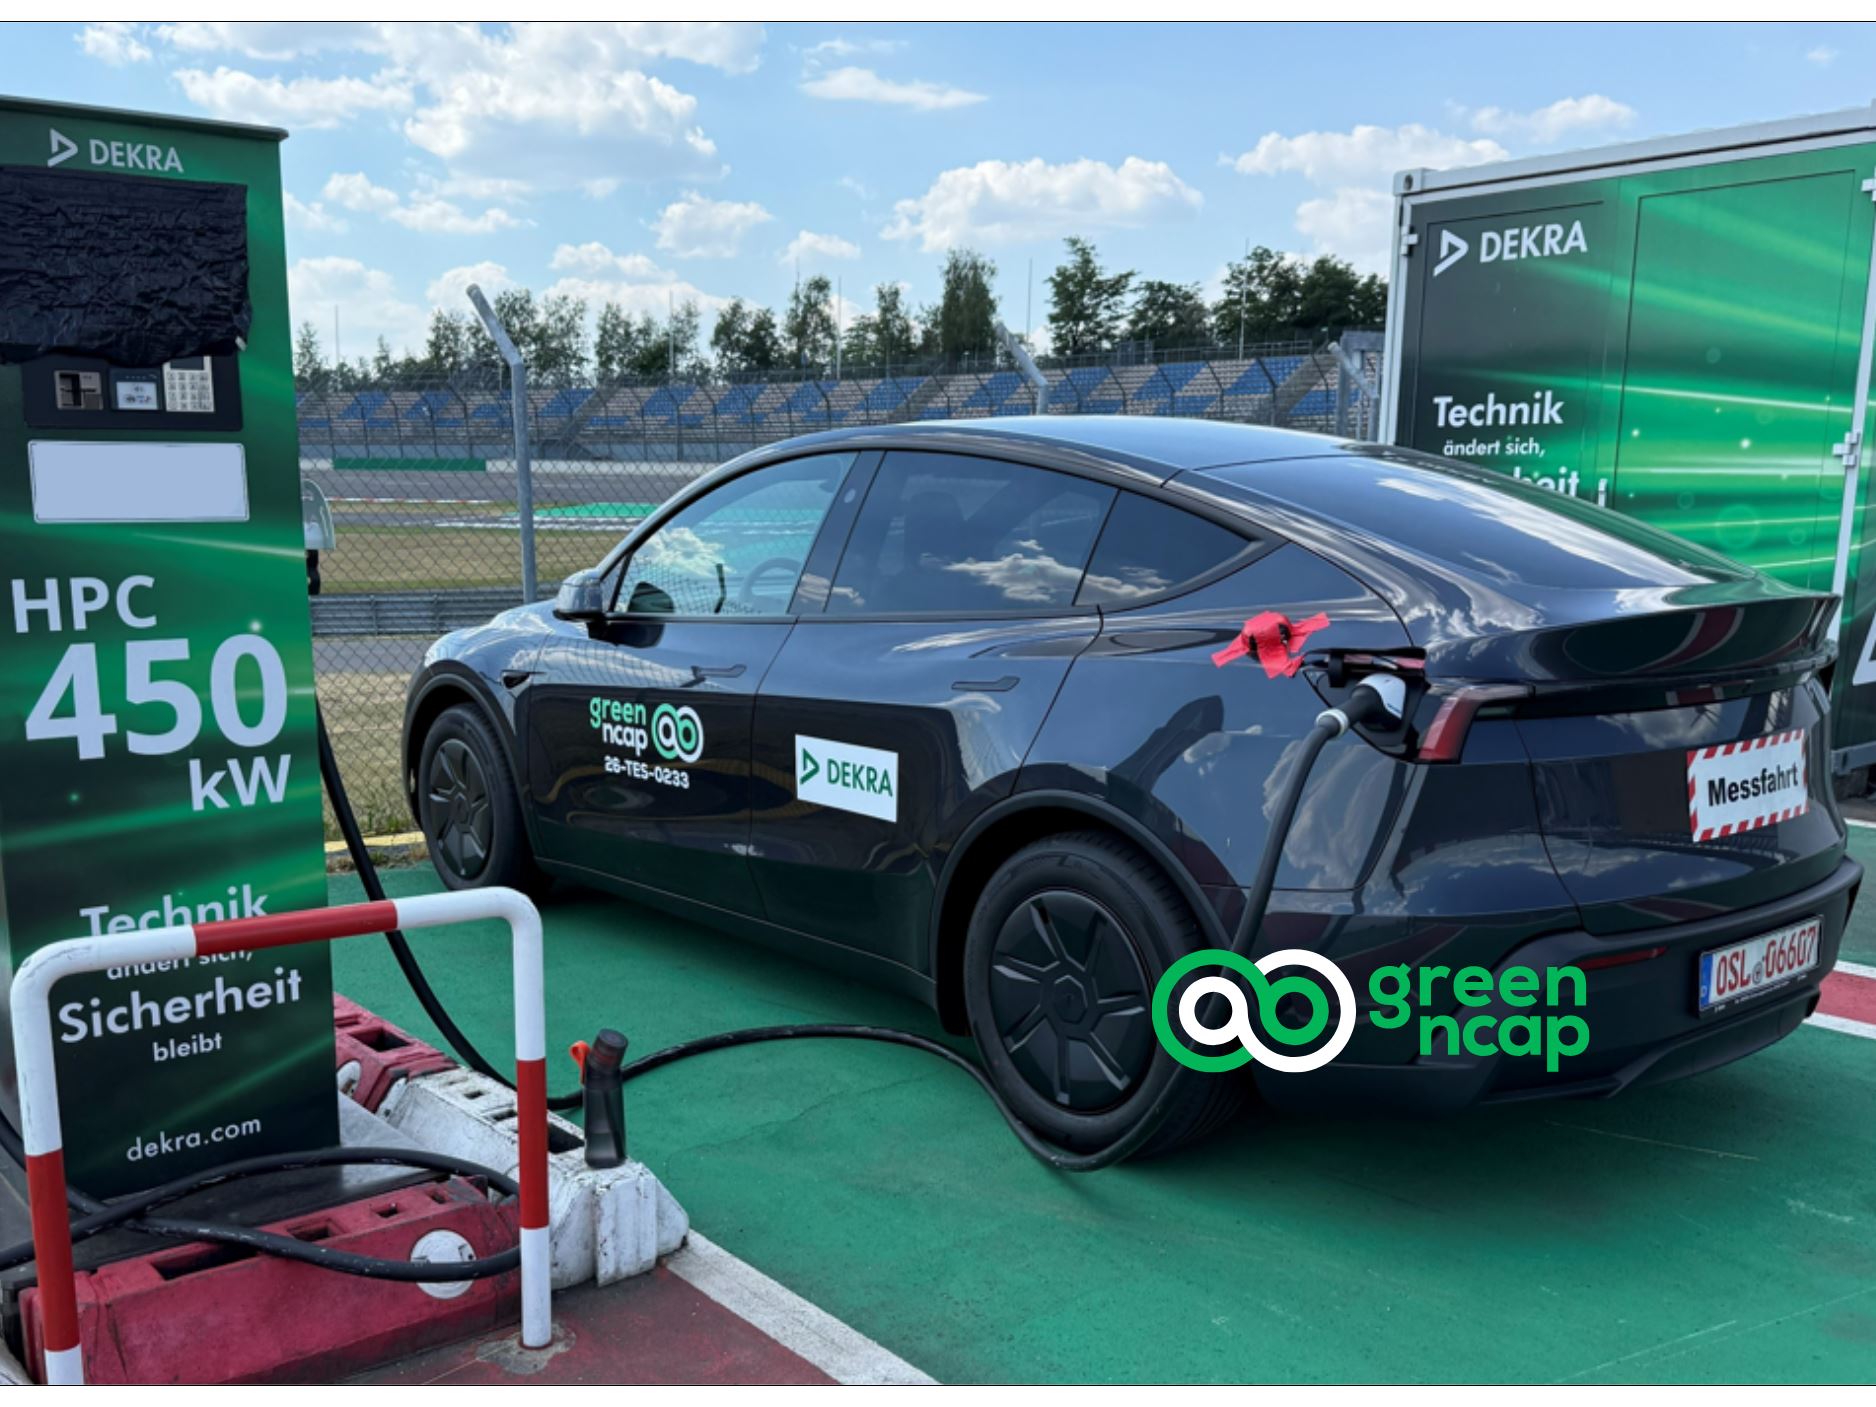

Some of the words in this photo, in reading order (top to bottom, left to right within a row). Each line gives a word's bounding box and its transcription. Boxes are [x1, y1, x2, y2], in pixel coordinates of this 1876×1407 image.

[89, 139, 184, 173] DEKRA
[1479, 220, 1588, 264] DEKRA
[1433, 390, 1564, 428] Technik
[1443, 438, 1500, 456] ändert
[1505, 437, 1545, 458] sich,
[11, 575, 157, 633] HPC
[25, 633, 288, 760] 450
[589, 697, 647, 729] green
[602, 722, 648, 757] ncap
[189, 754, 291, 811] kW
[604, 755, 690, 789] 26-TES-0233
[827, 758, 893, 797] DEKRA
[1708, 763, 1799, 807] Messfahrt
[80, 884, 268, 936] Technik
[1716, 949, 1751, 997] OSL
[1764, 926, 1817, 978] 06607
[58, 966, 302, 1043] Sicherheit
[153, 1032, 223, 1062] bleibt
[126, 1118, 262, 1161] dekra.com
